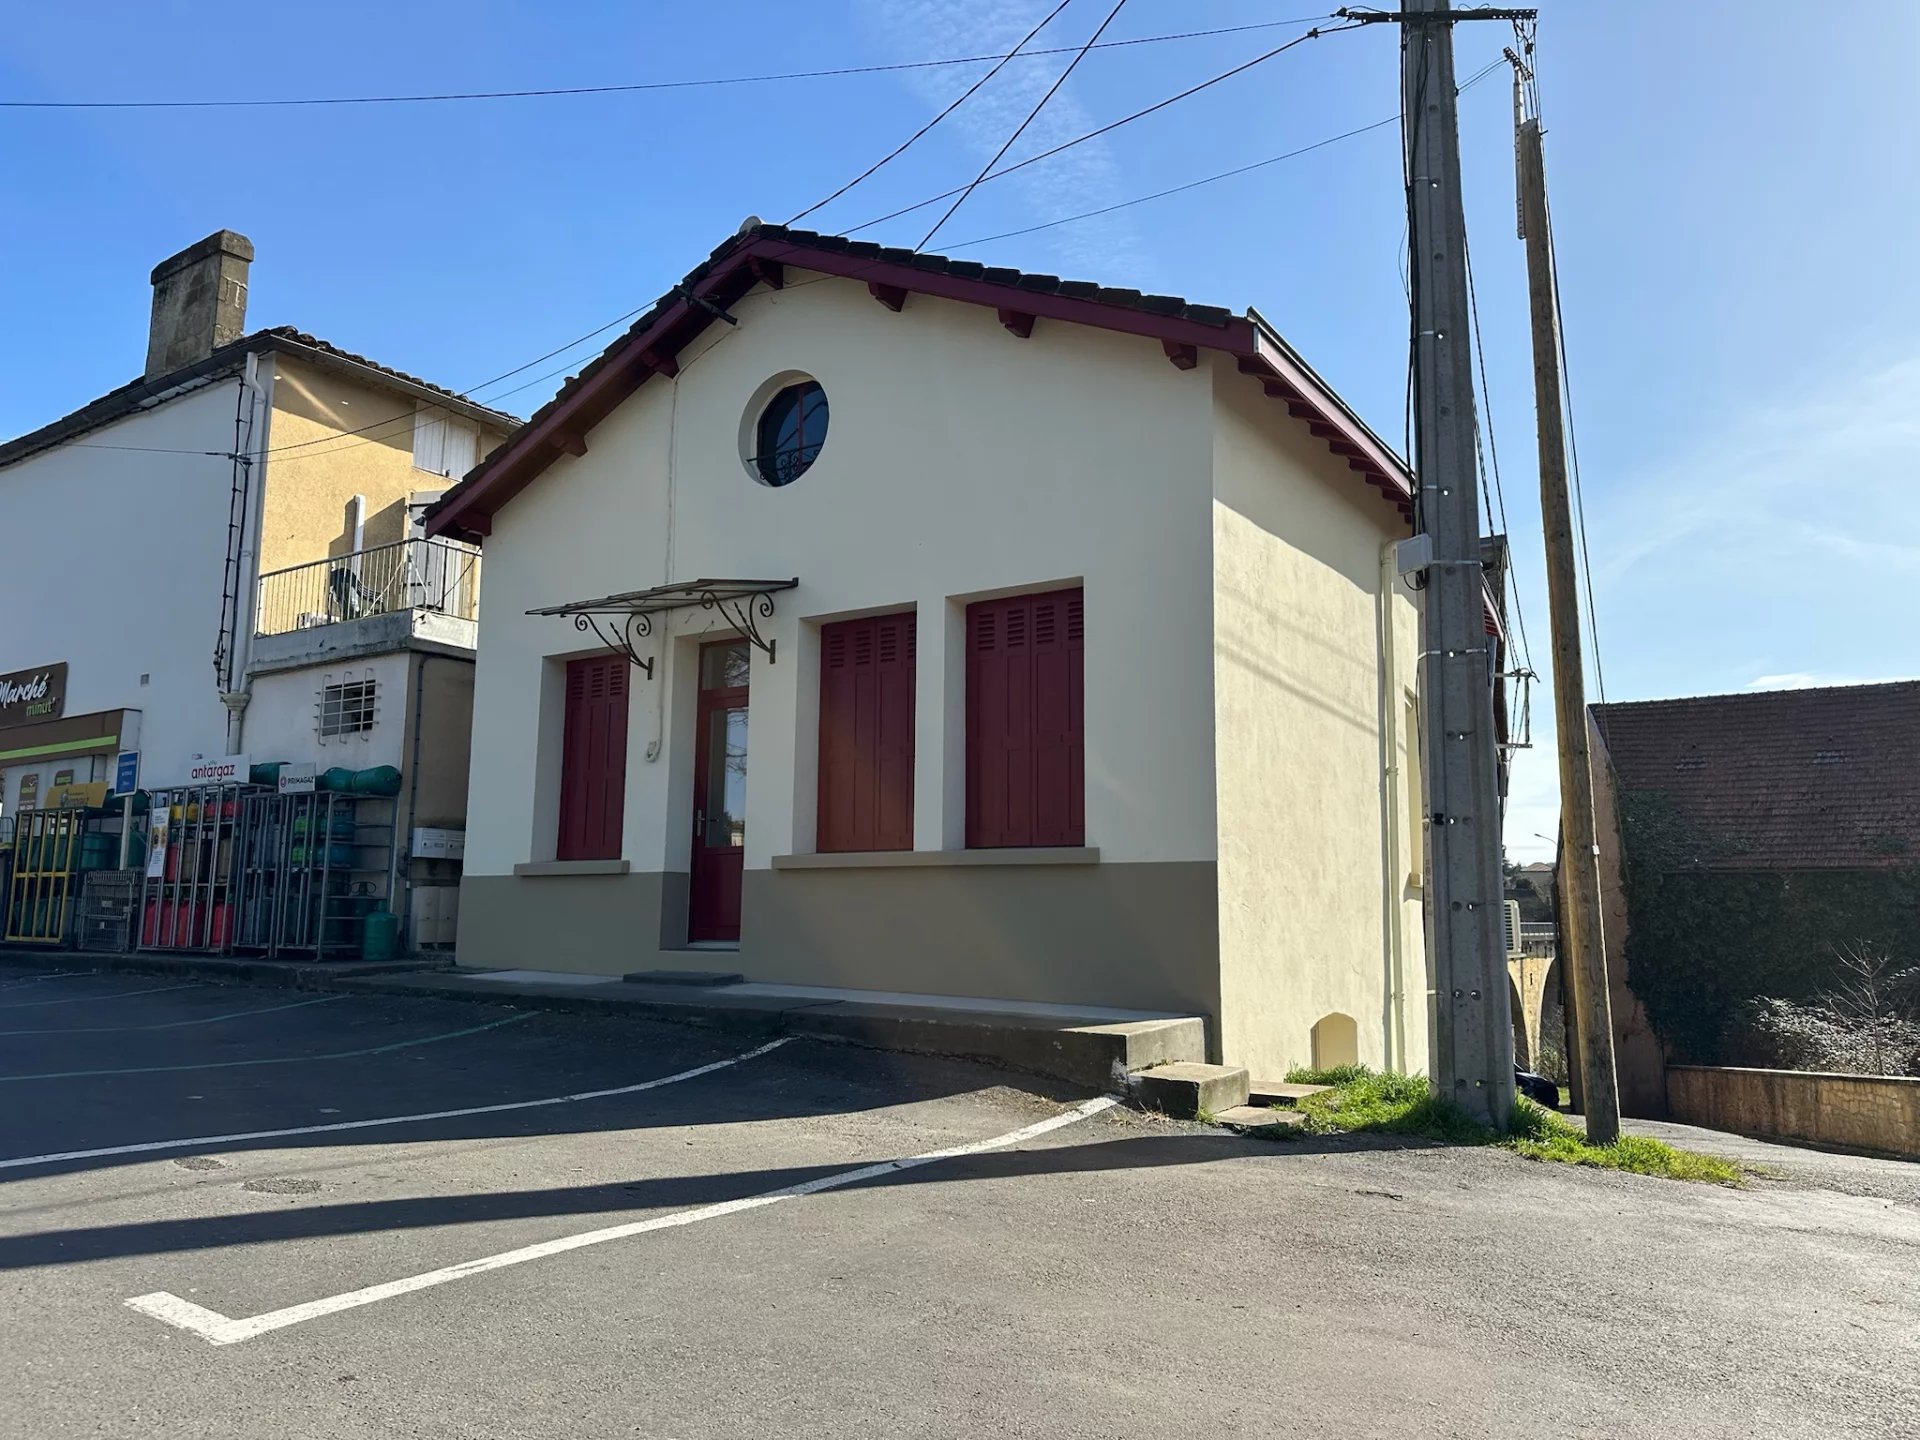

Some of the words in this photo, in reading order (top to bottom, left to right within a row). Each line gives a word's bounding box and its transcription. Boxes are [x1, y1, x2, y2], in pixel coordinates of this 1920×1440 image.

[0, 672, 49, 709] Marché
[191, 764, 236, 782] antargaz
[287, 776, 314, 785] PRIMAGAZ
